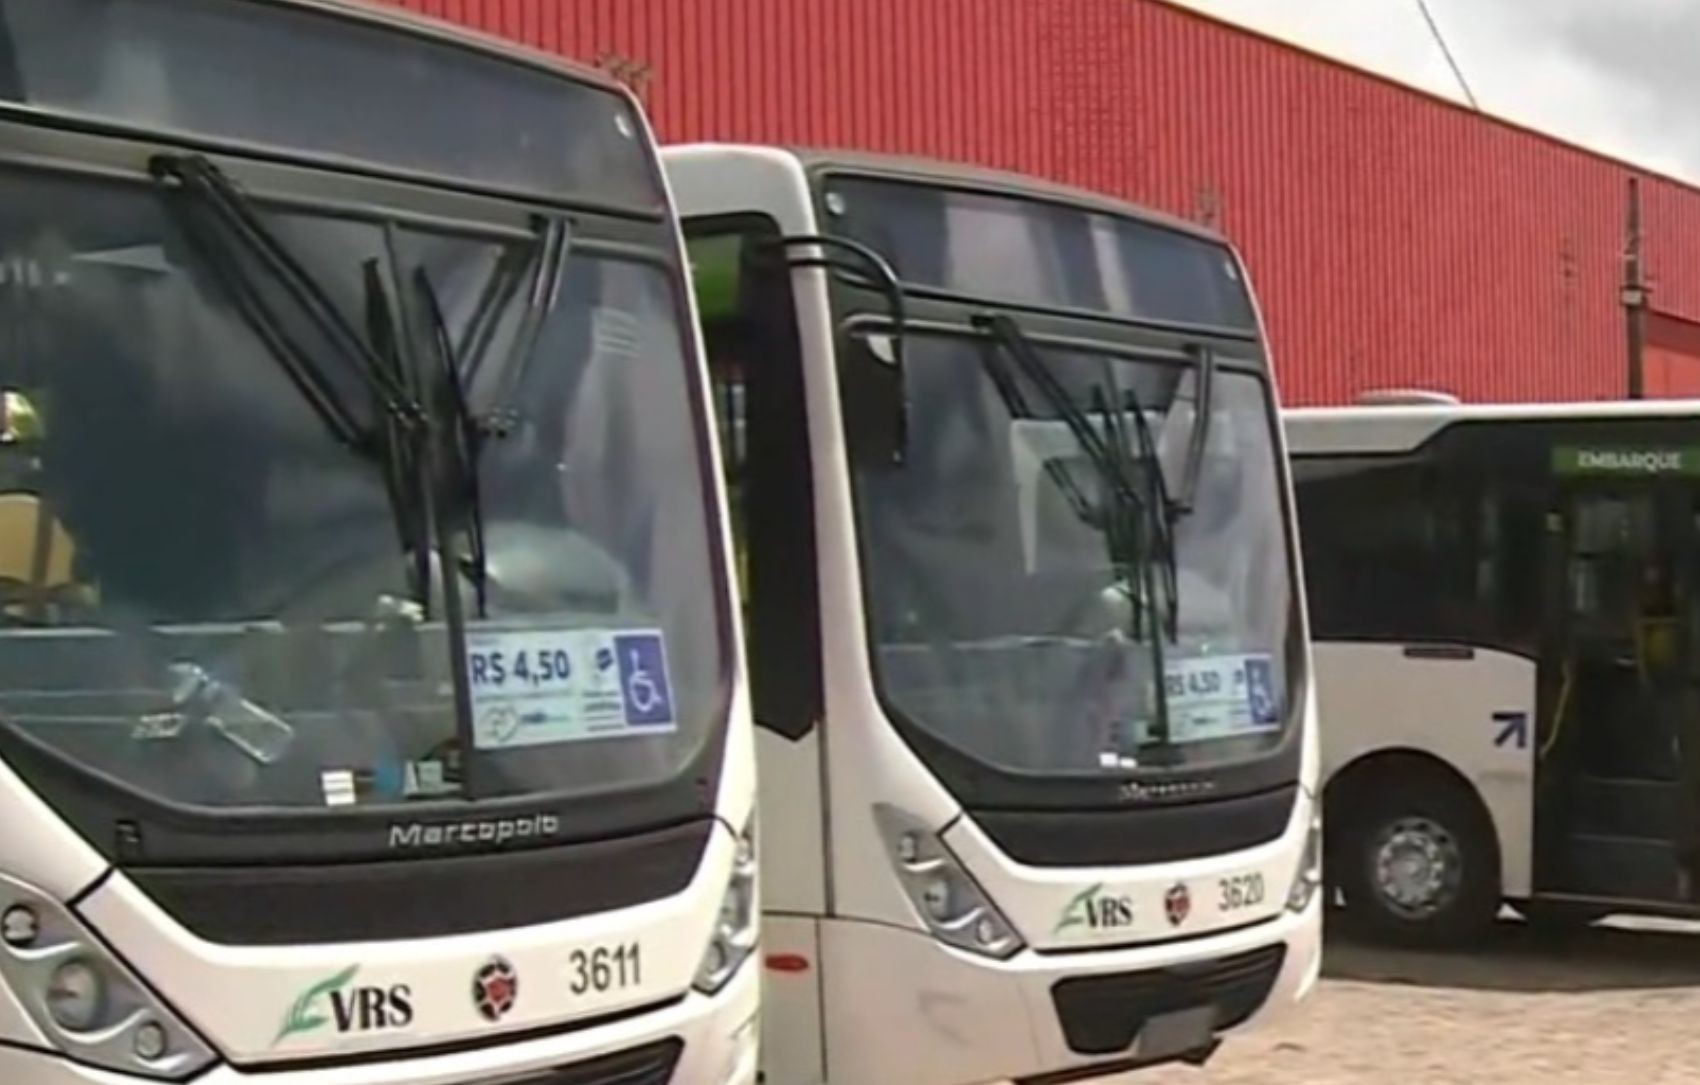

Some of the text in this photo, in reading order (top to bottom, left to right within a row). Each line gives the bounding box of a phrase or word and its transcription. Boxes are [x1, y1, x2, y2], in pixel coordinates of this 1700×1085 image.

[1577, 451, 1682, 473] EMBARQUE
[513, 648, 571, 687] 4,50
[388, 814, 560, 848] Marcopolo
[1217, 872, 1265, 912] 3620
[1084, 895, 1133, 929] VRS
[568, 942, 642, 995] 3611
[328, 983, 414, 1033] VRS
